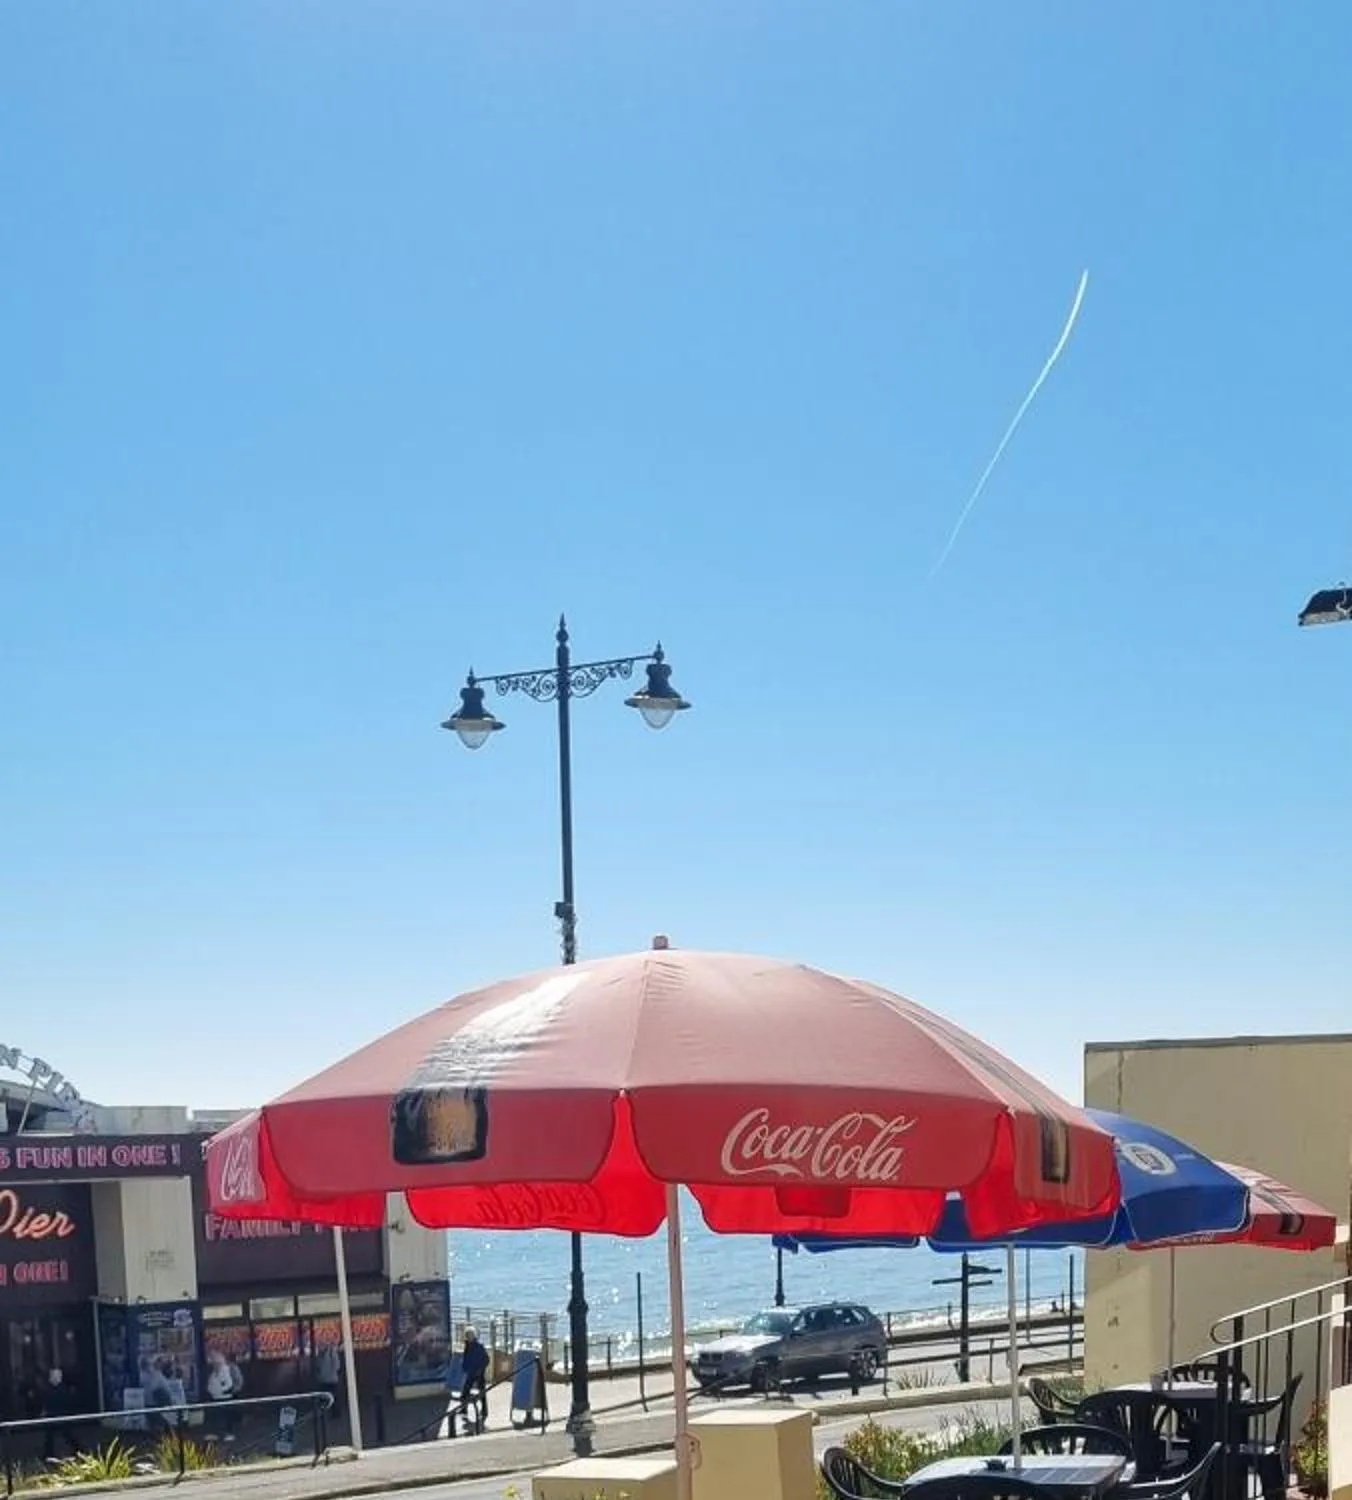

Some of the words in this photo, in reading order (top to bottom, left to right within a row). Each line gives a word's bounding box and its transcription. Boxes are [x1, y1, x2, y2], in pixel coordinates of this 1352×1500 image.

[16, 1147, 73, 1169] FUN
[77, 1145, 107, 1167] IN
[721, 1107, 919, 1181] Coca-Cola
